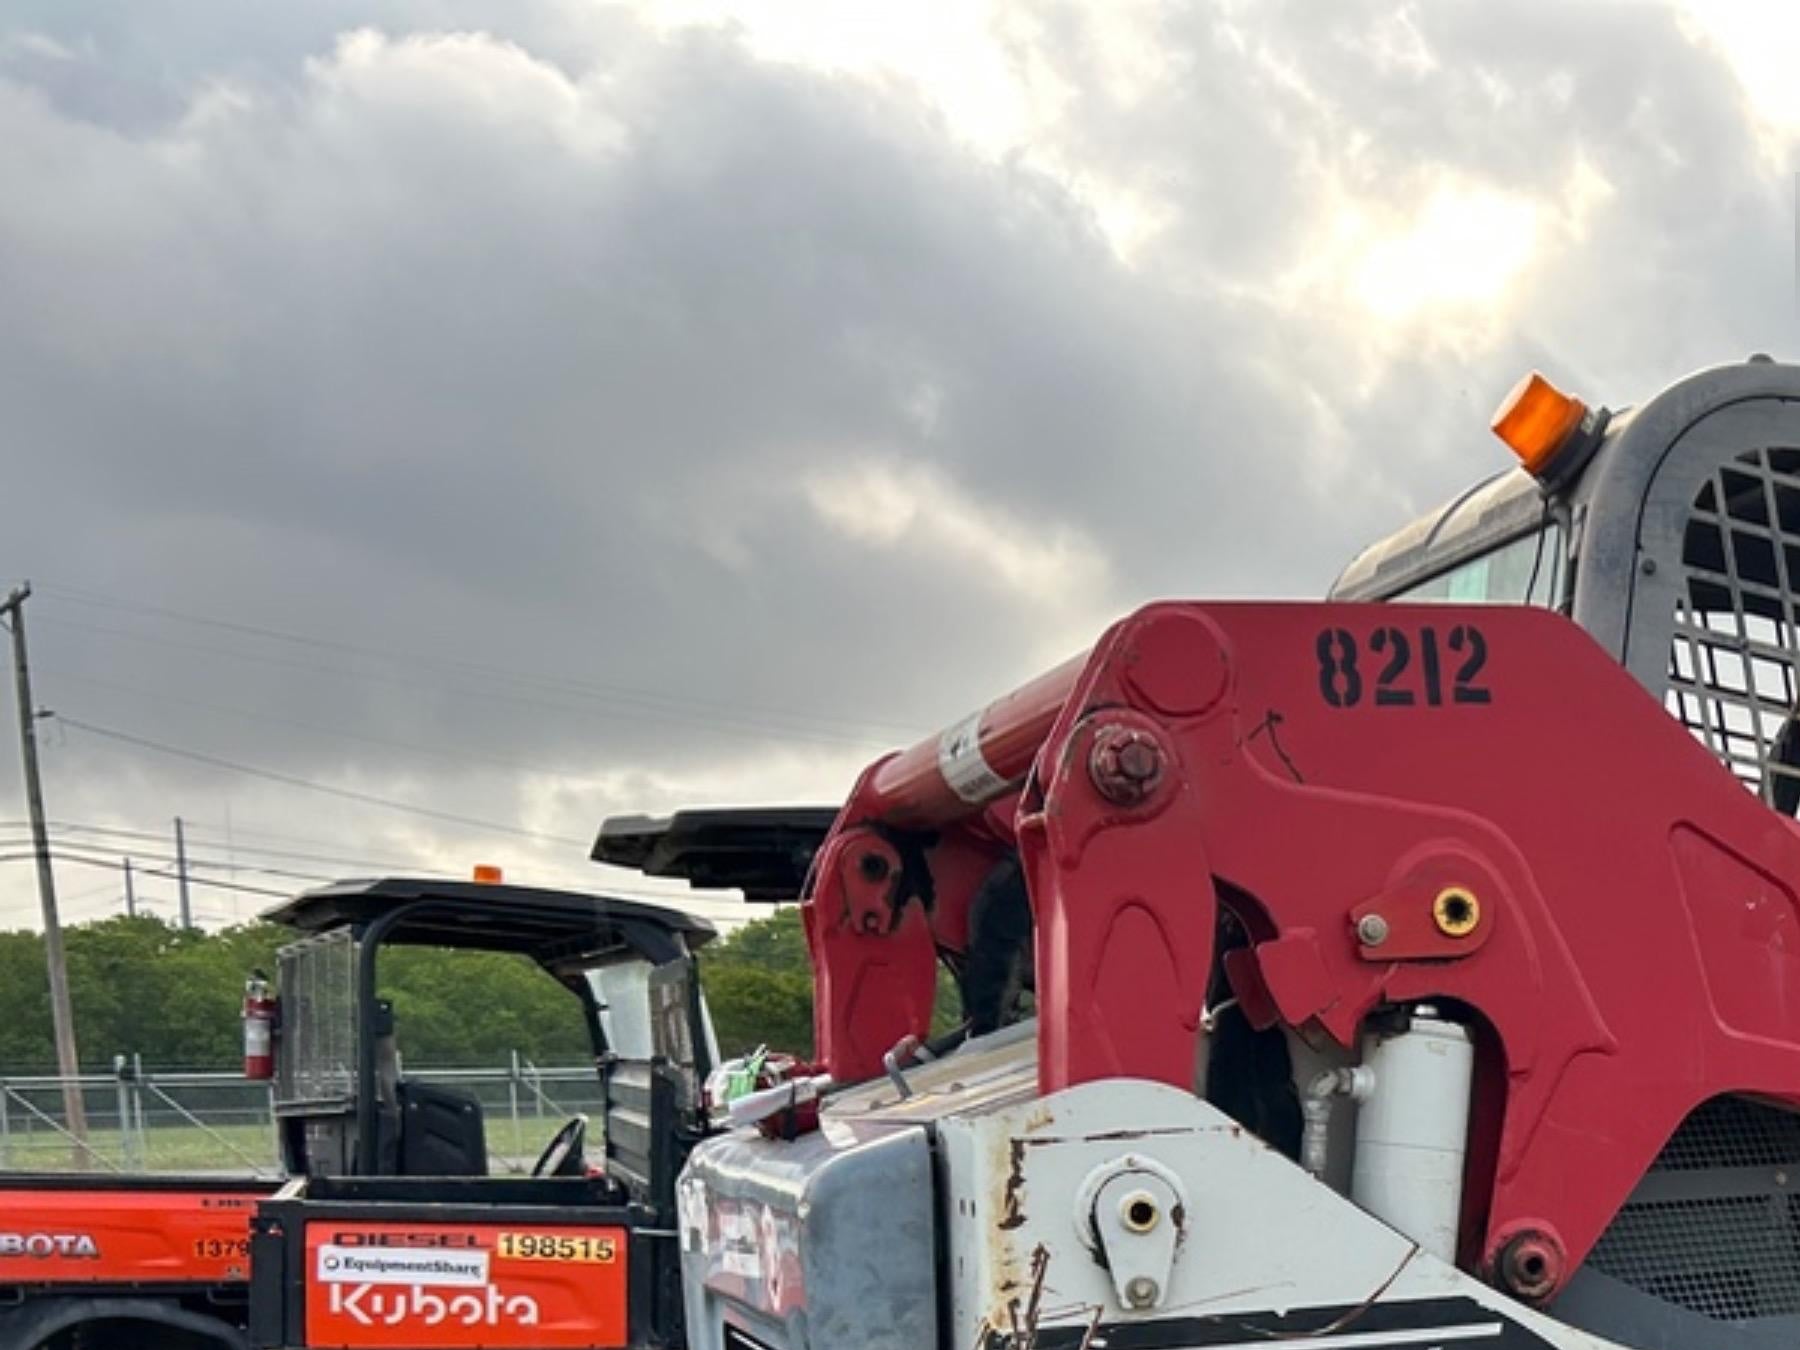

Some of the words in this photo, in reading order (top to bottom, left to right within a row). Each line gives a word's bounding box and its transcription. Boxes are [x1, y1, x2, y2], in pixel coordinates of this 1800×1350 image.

[1316, 625, 1493, 708] 8212
[501, 1232, 614, 1261] 198515
[343, 1253, 481, 1278] EquipmentShare
[329, 1281, 539, 1326] Kubota
